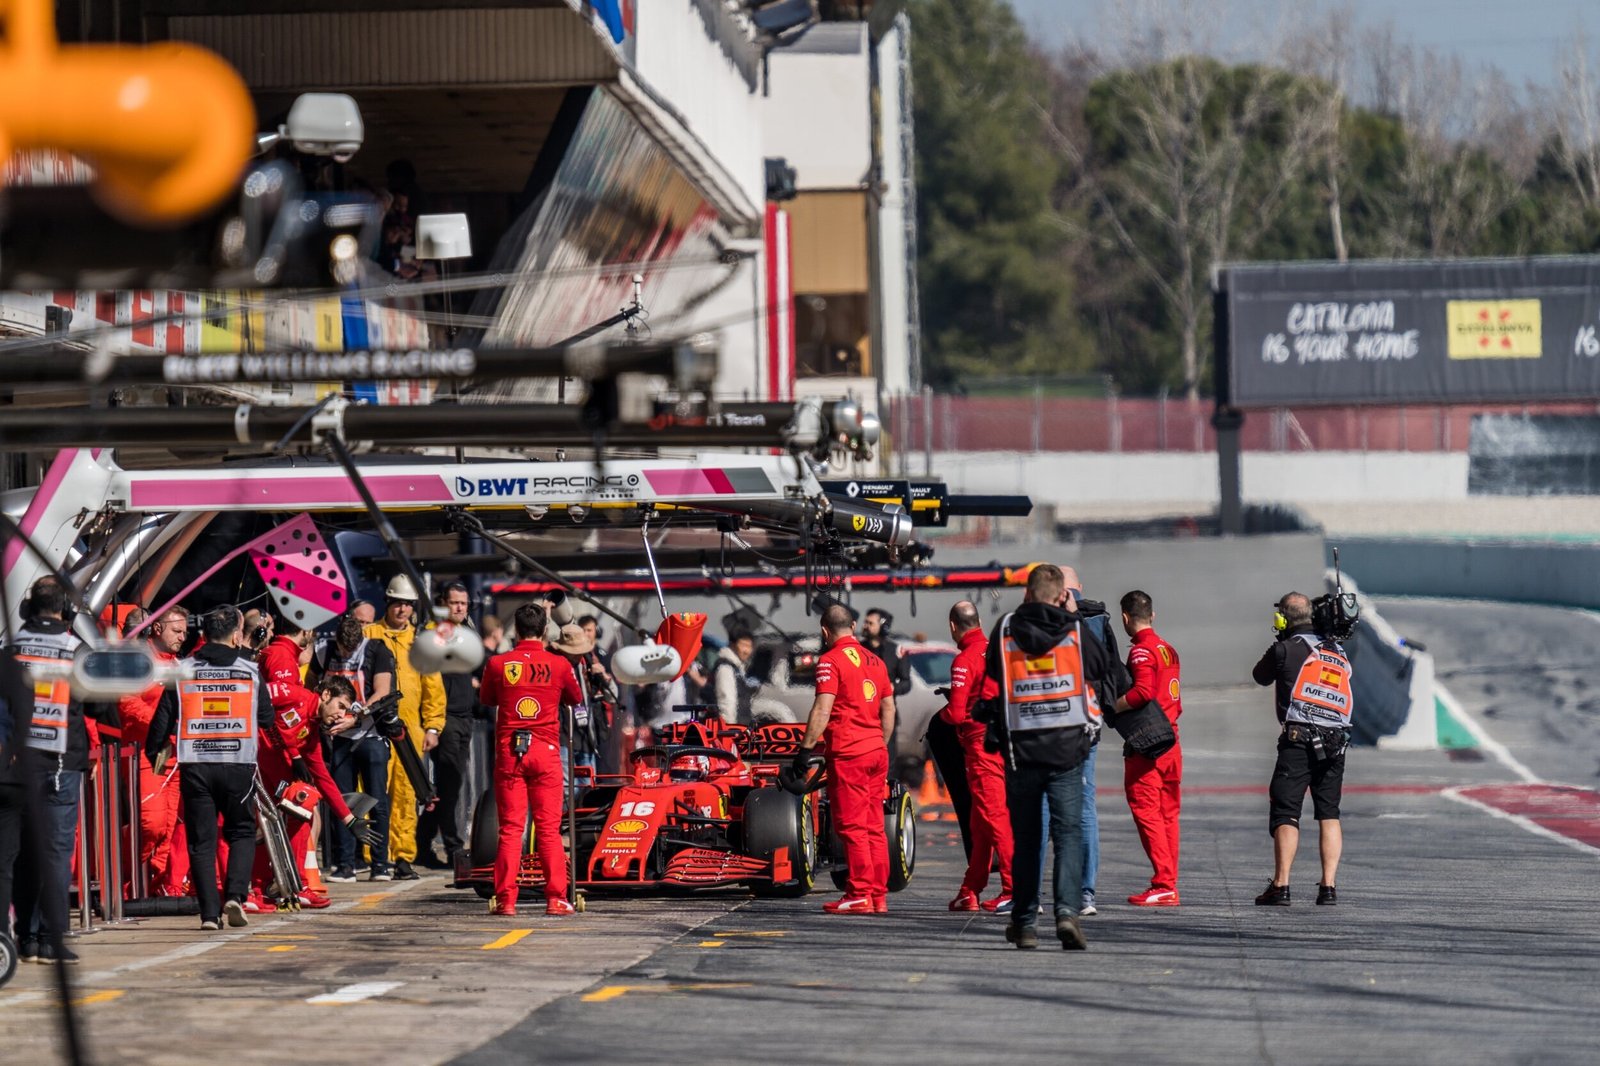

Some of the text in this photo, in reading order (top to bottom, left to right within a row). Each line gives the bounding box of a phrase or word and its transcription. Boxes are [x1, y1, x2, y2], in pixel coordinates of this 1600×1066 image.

[1294, 331, 1349, 365] YOUR
[1354, 328, 1421, 361] HOME
[478, 475, 623, 497] BWT RACING
[196, 684, 237, 692] TESTING
[1015, 679, 1071, 692] MEDIA
[1305, 686, 1345, 705] MEDIA
[34, 706, 62, 716] DIA
[190, 722, 243, 730] MEDIA
[620, 801, 656, 817] 16
